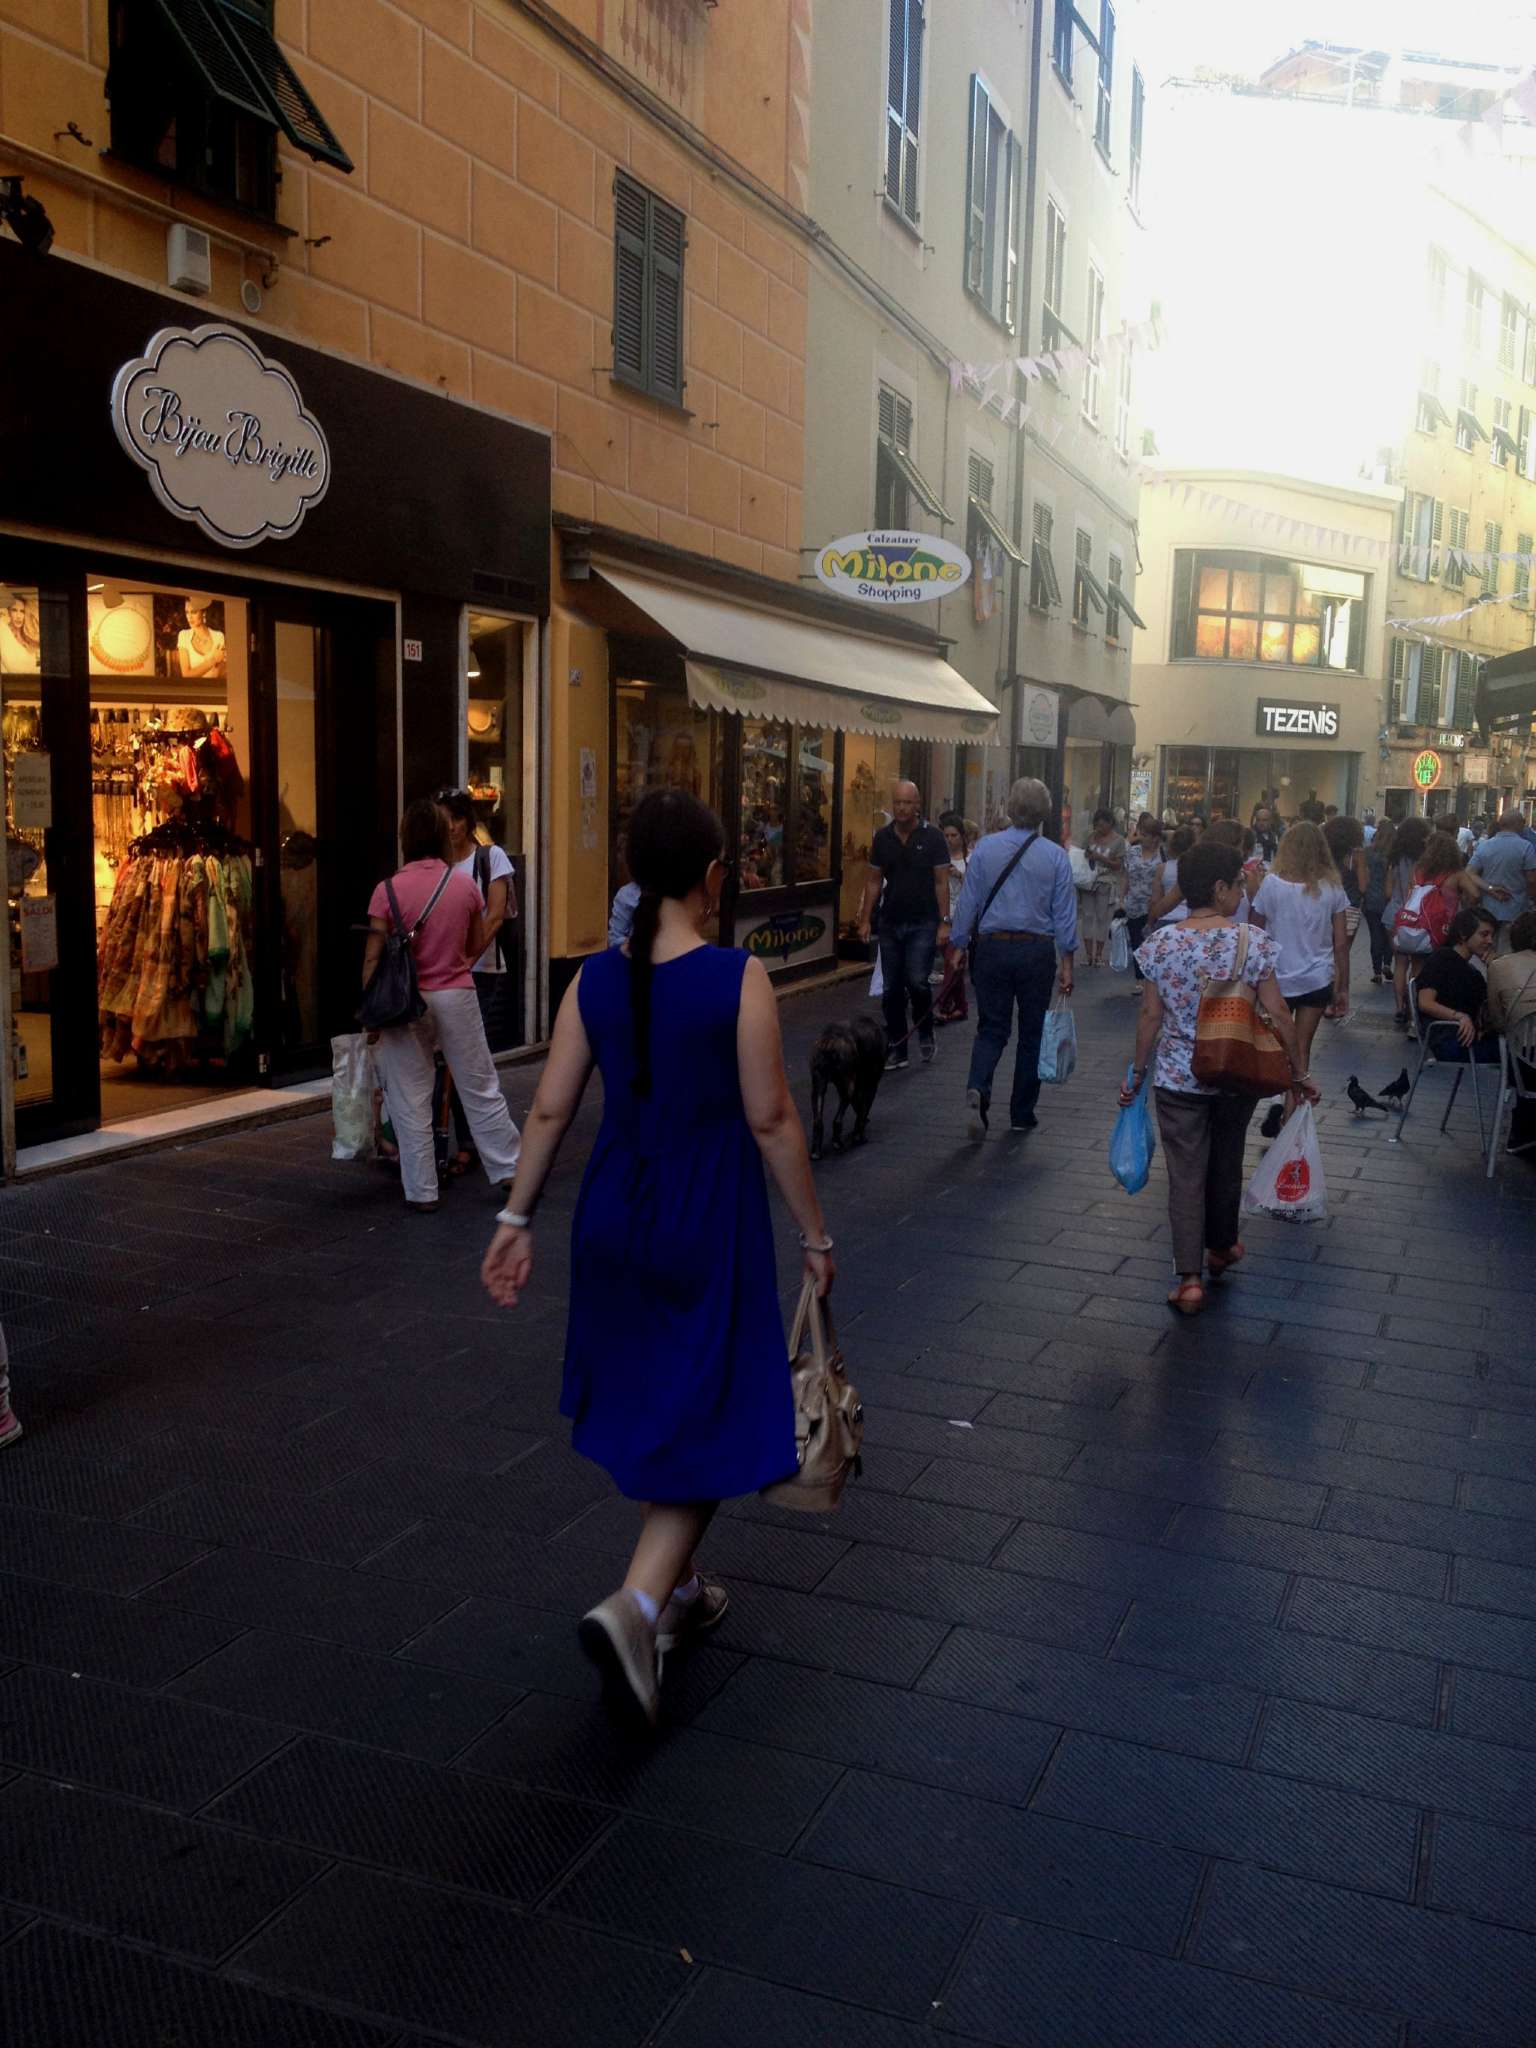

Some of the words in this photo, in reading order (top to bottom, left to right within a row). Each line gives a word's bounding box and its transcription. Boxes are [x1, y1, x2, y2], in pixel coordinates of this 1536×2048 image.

[140, 386, 221, 457] Bijou
[867, 534, 921, 544] Calzature
[822, 549, 962, 582] Milone
[858, 583, 921, 601] Shopping
[407, 643, 420, 657] 151
[748, 926, 820, 952] Milone
